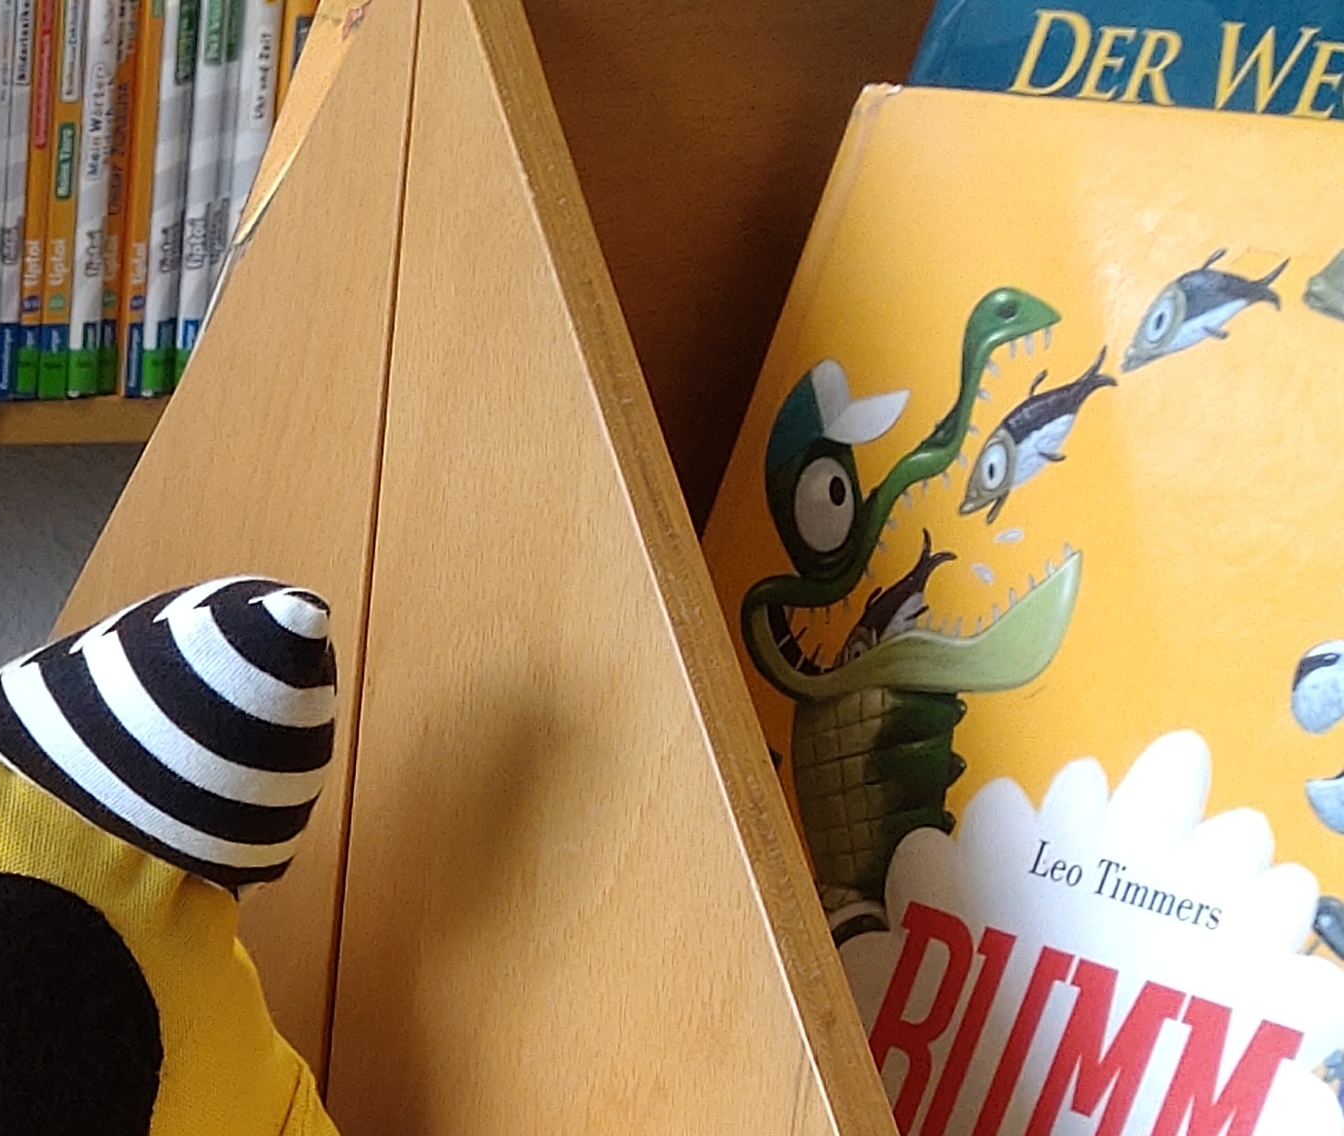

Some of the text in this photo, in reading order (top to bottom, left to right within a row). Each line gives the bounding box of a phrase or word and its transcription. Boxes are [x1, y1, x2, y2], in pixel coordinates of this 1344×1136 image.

[1009, 9, 1183, 106] DER
[1028, 838, 1222, 931] Leo Timmers
